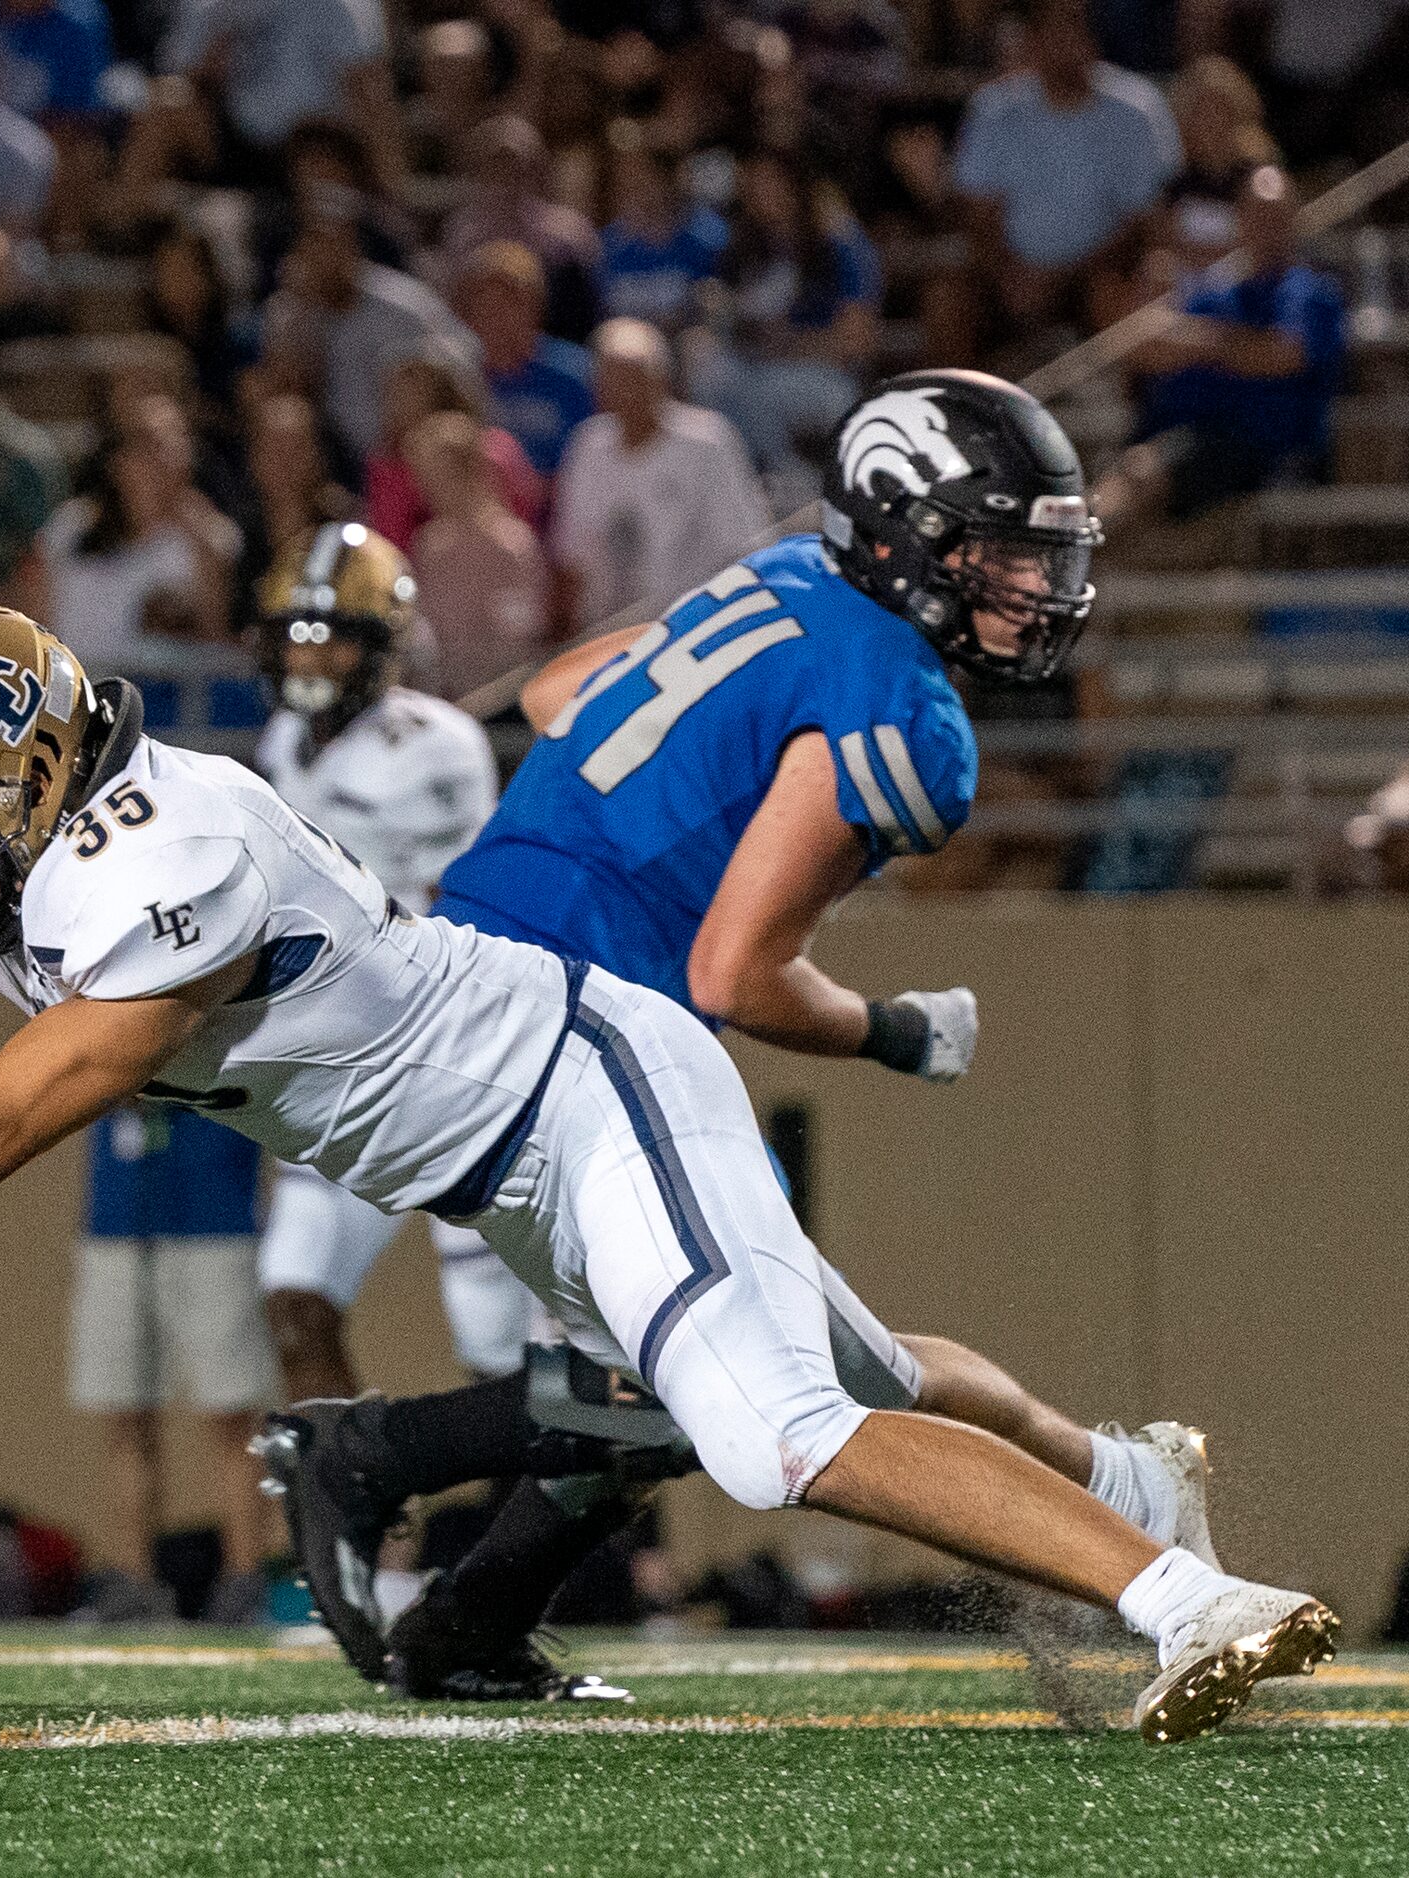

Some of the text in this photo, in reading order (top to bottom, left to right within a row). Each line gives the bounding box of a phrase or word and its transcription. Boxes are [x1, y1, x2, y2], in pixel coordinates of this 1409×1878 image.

[546, 562, 807, 797] 54
[63, 777, 158, 862] 35
[143, 900, 201, 951] LE
